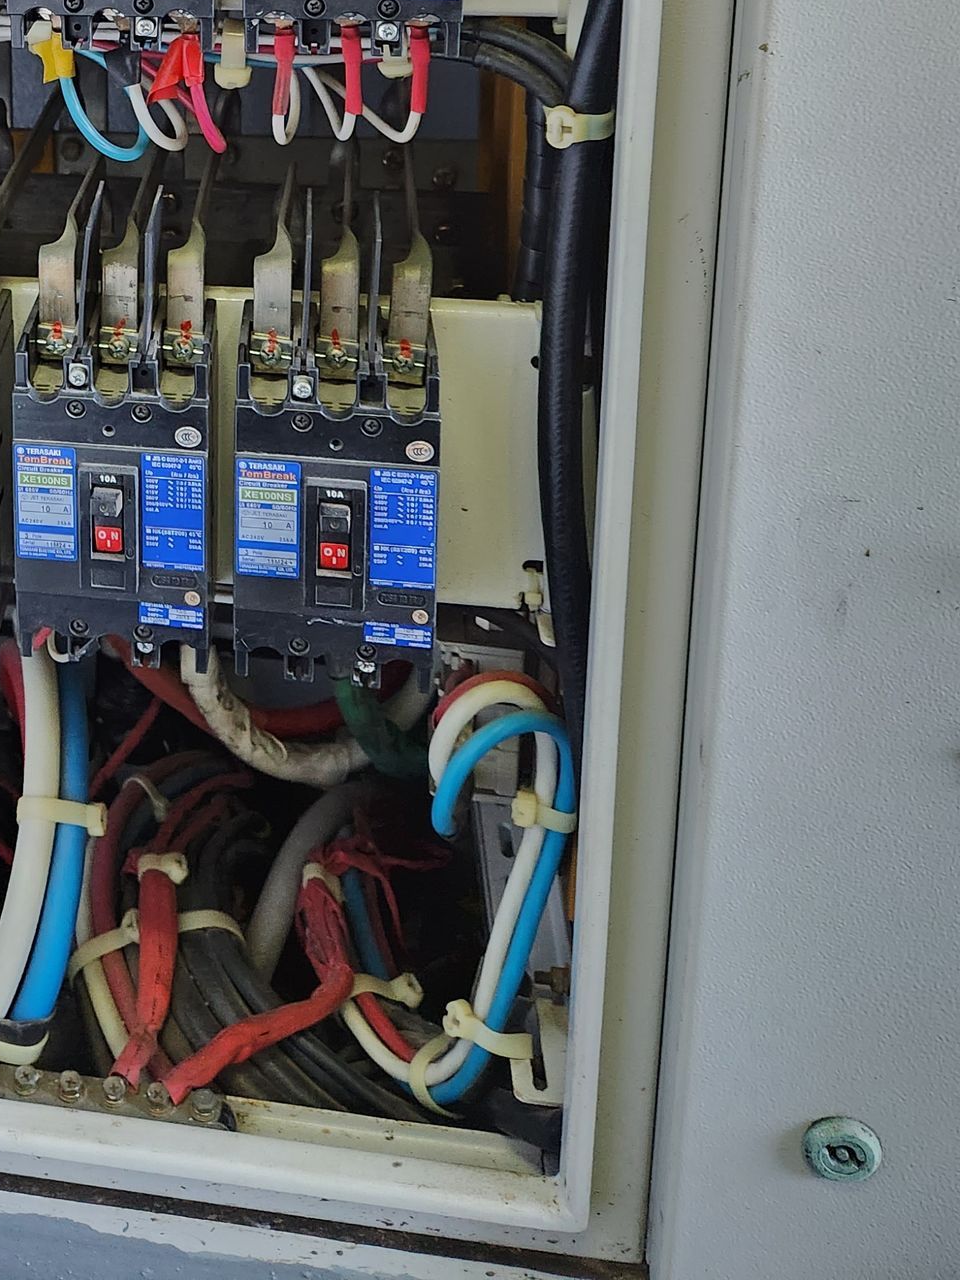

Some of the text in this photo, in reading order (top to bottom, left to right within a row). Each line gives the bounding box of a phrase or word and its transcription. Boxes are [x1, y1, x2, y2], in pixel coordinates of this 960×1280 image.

[26, 448, 61, 456] TERASAKI
[19, 456, 72, 465] TemBreak
[249, 463, 285, 471] TERASAKI
[100, 475, 116, 483] 10A
[241, 471, 296, 480] TemBreak
[22, 476, 67, 485] XE100NS
[244, 490, 292, 501] XE100NS
[326, 490, 344, 498] 10A
